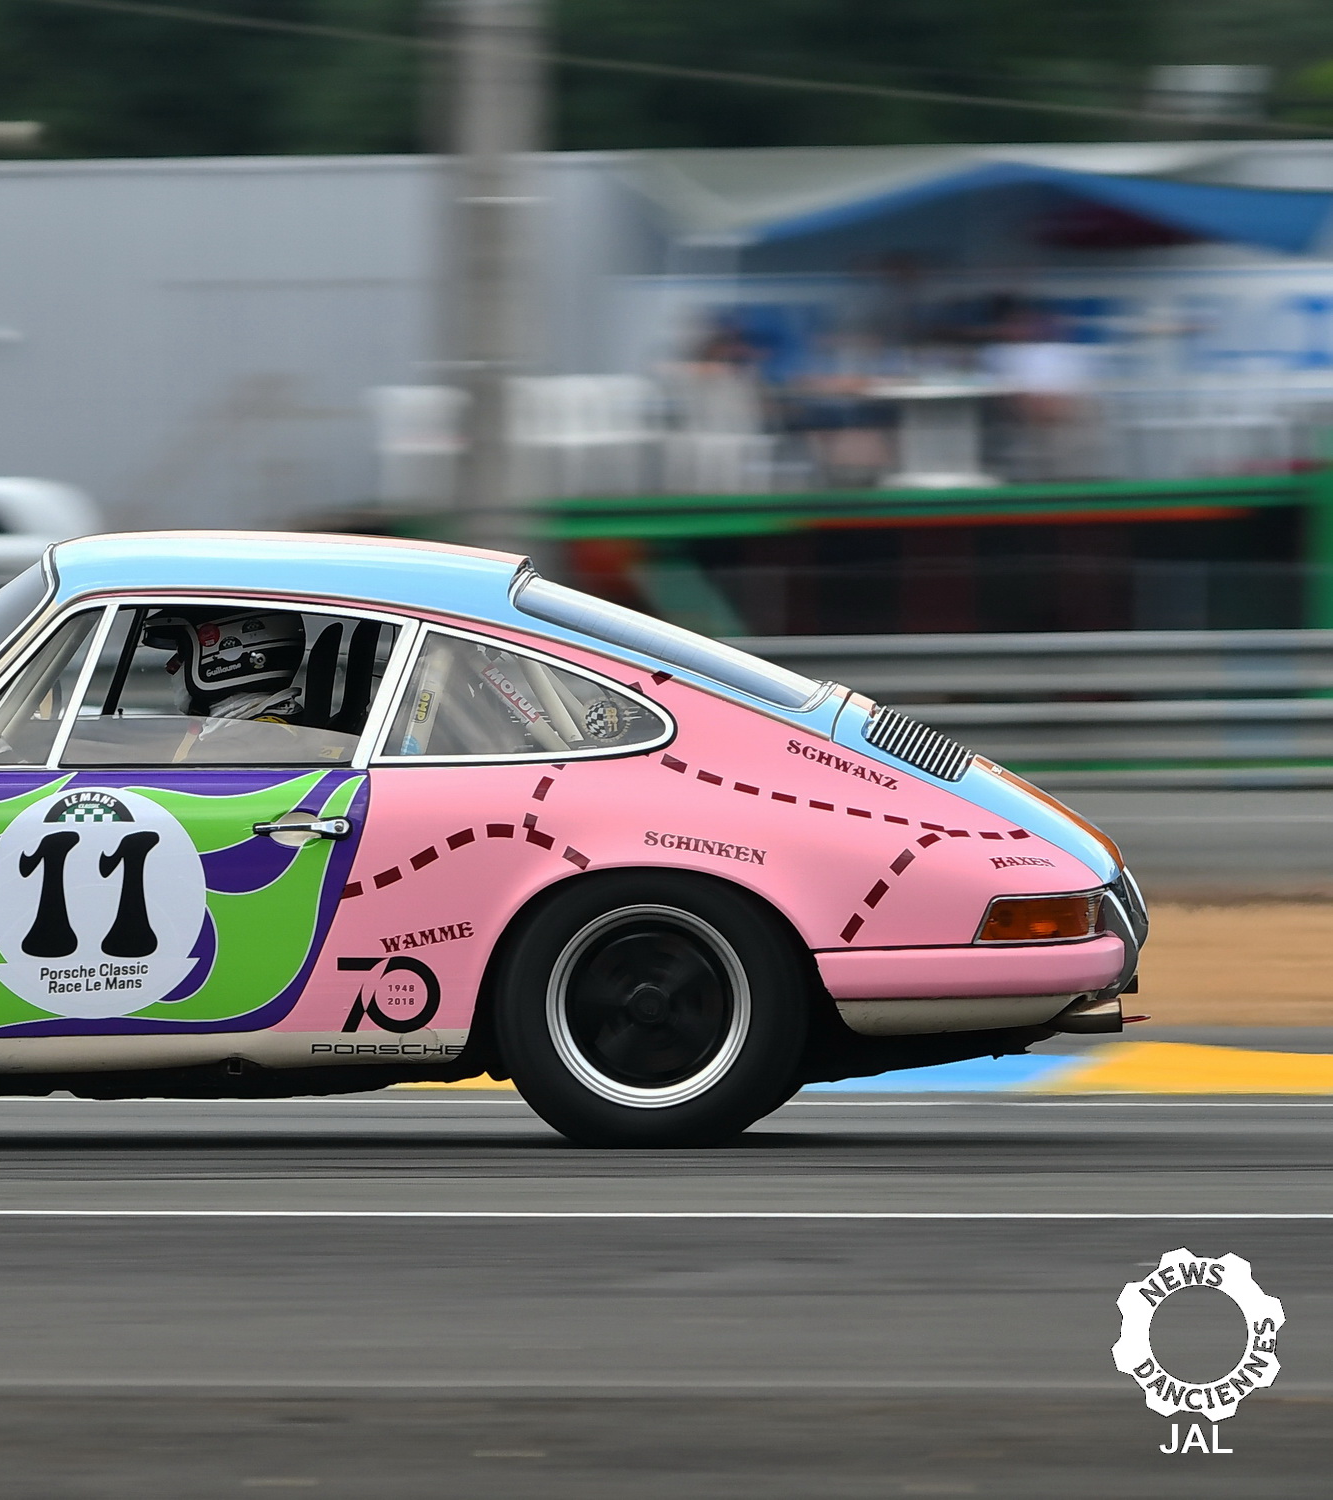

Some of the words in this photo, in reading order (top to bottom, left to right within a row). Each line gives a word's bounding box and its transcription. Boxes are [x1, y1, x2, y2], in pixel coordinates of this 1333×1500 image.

[206, 662, 242, 677] Guillaume
[484, 667, 539, 719] MOTUL
[786, 739, 899, 791] SCHWANZ
[63, 794, 78, 808] LE
[79, 792, 118, 808] MANS
[643, 830, 767, 866] SCHINKEN
[989, 856, 1056, 870] HAXEN
[19, 830, 160, 959] 11
[379, 921, 475, 954] WAMME
[40, 965, 96, 981] Porsche
[99, 961, 149, 977] Classic
[48, 981, 82, 994] Race
[85, 979, 102, 992] Le
[105, 977, 143, 991] Mans
[387, 984, 415, 993] 1948
[337, 956, 441, 1034] 70
[387, 998, 415, 1006] 2018
[311, 1044, 466, 1055] PORSCHE
